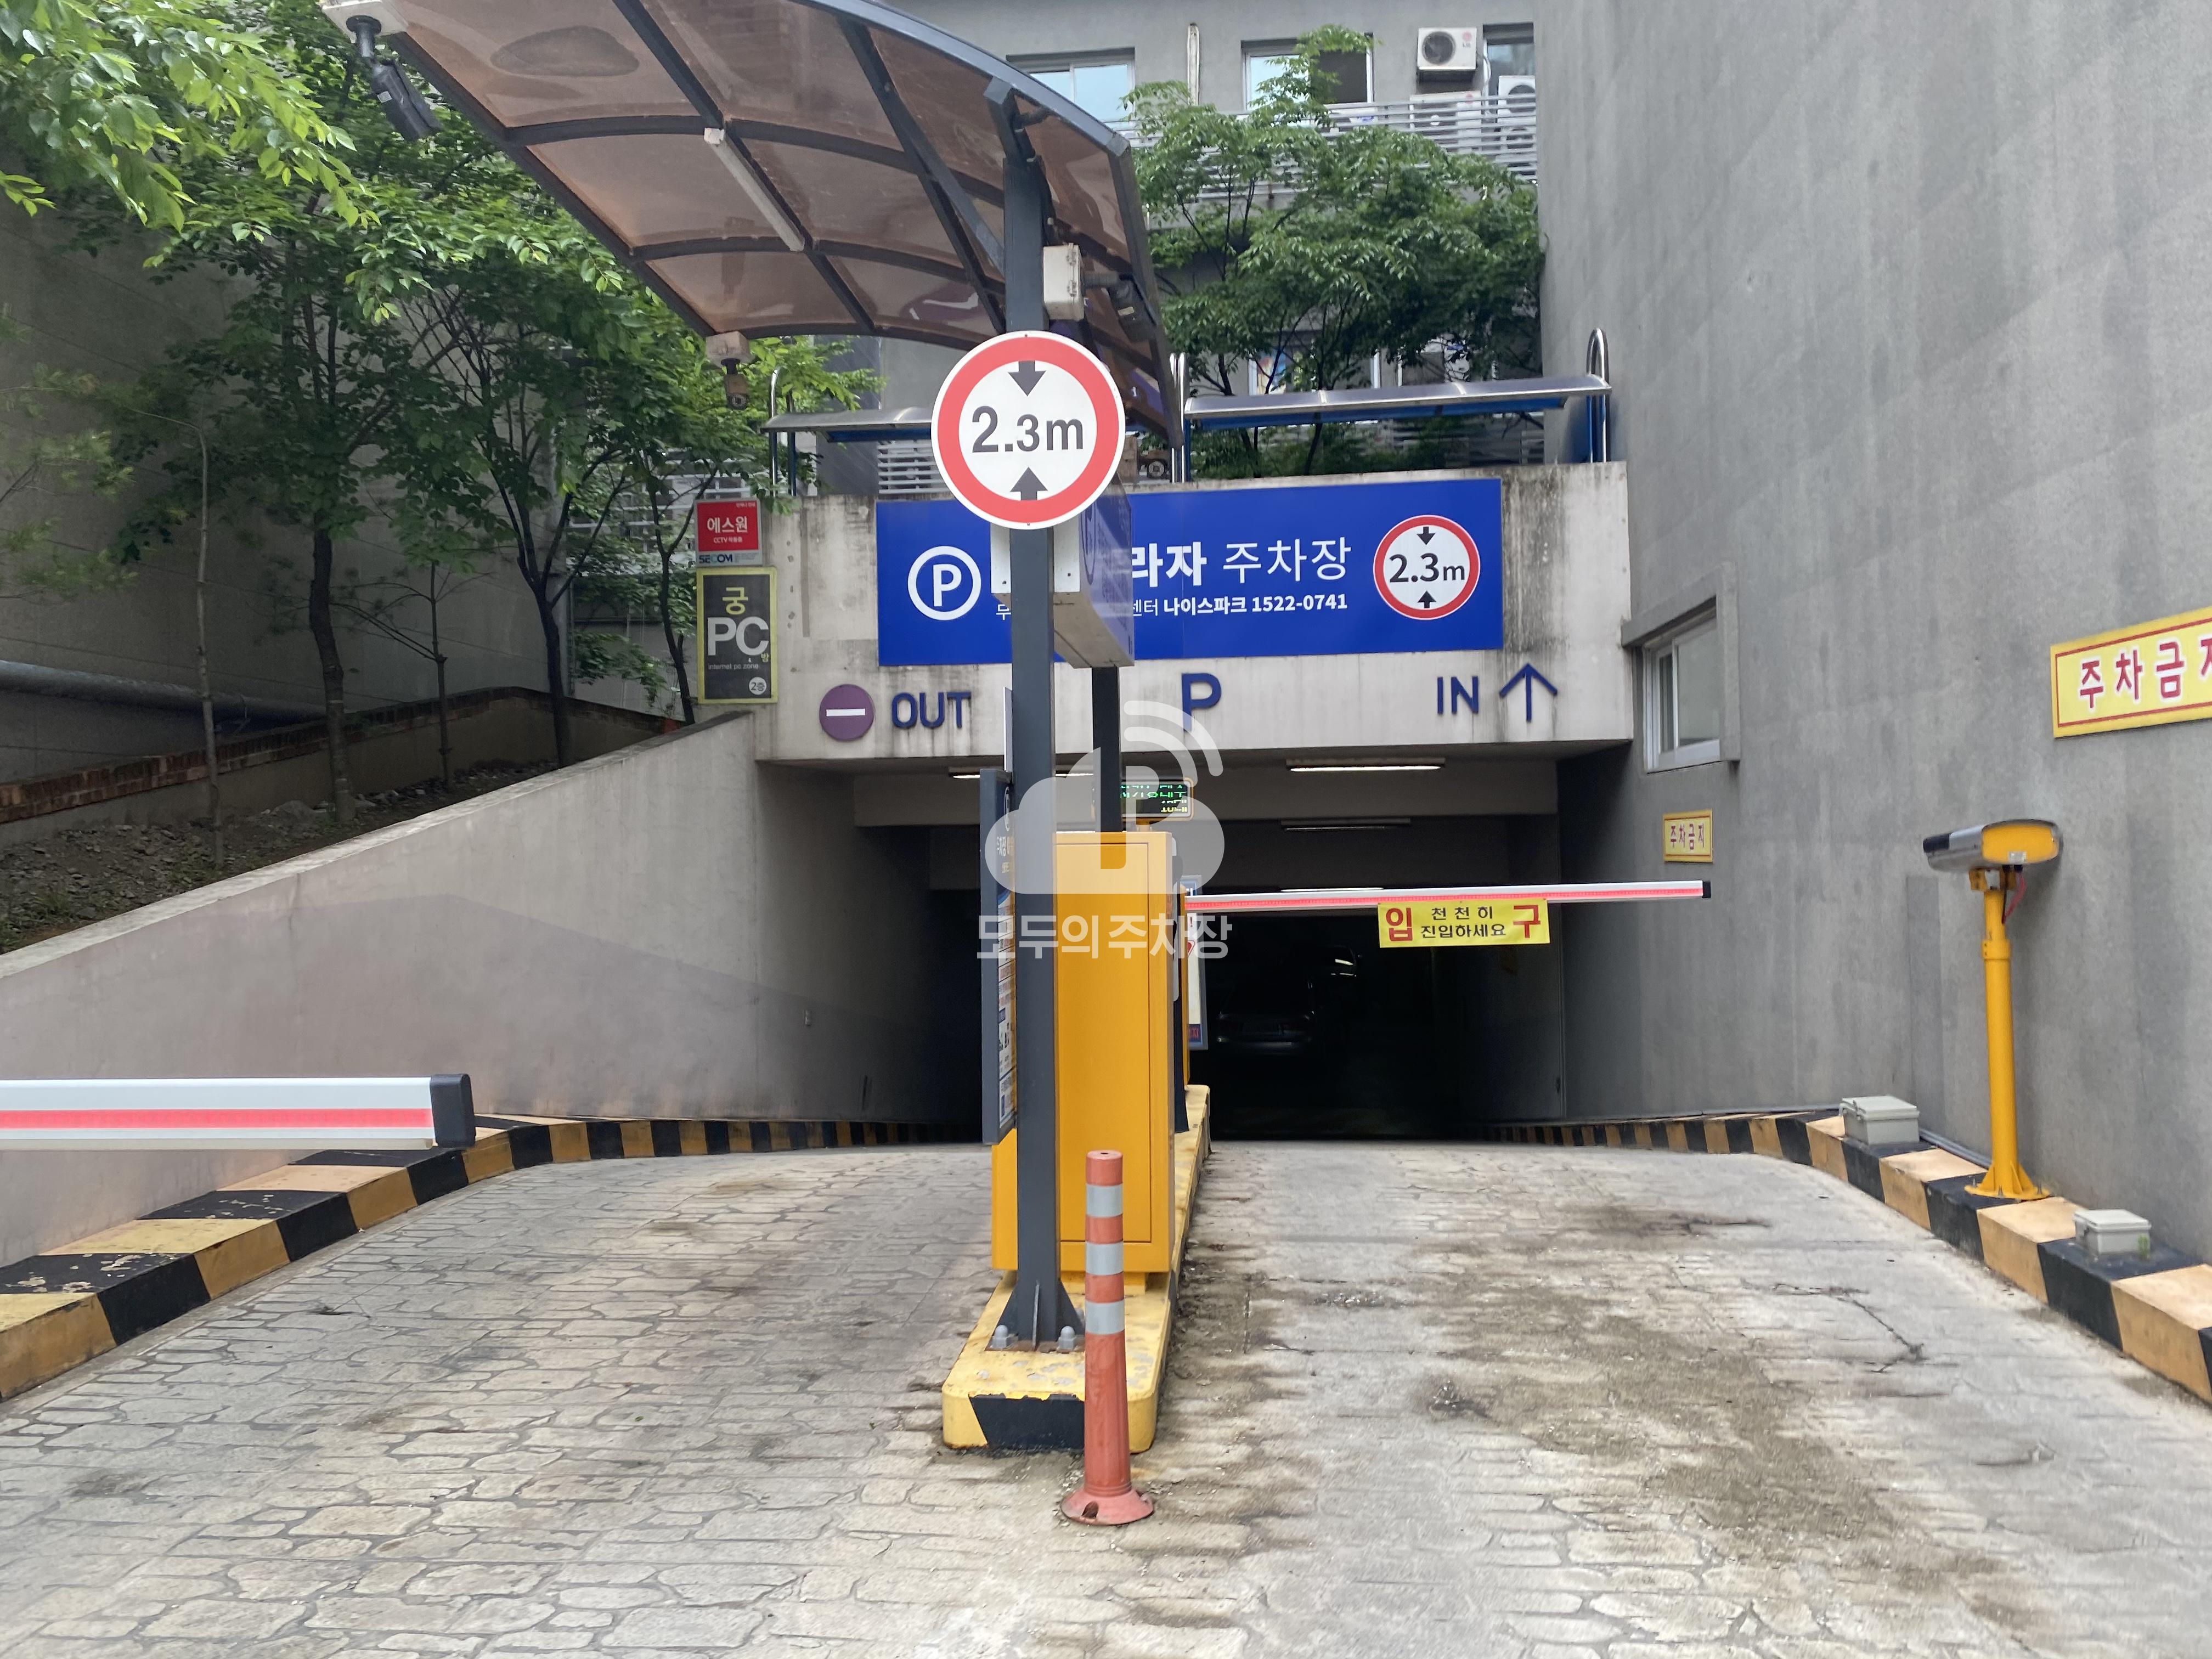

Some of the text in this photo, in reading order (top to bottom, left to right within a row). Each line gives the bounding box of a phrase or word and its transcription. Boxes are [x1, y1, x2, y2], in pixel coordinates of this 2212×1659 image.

[972, 405, 1084, 453] 2.3m
[707, 516, 748, 533] 에스원
[699, 554, 733, 563] SECOM
[1223, 537, 1351, 584] 주차장
[1389, 552, 1465, 583] 2.3m
[722, 587, 749, 615] 궁
[1164, 596, 1247, 616] 나이스파크
[1252, 594, 1348, 613] 1522-0741
[707, 616, 769, 656] PC
[751, 681, 765, 691] 2층
[1437, 676, 1480, 714] IN
[891, 692, 972, 729] OUT
[1181, 673, 1222, 731] P
[1670, 823, 1705, 850] 주차금지
[1385, 905, 1541, 941] 입 구
[1420, 924, 1506, 939] 진입하세요
